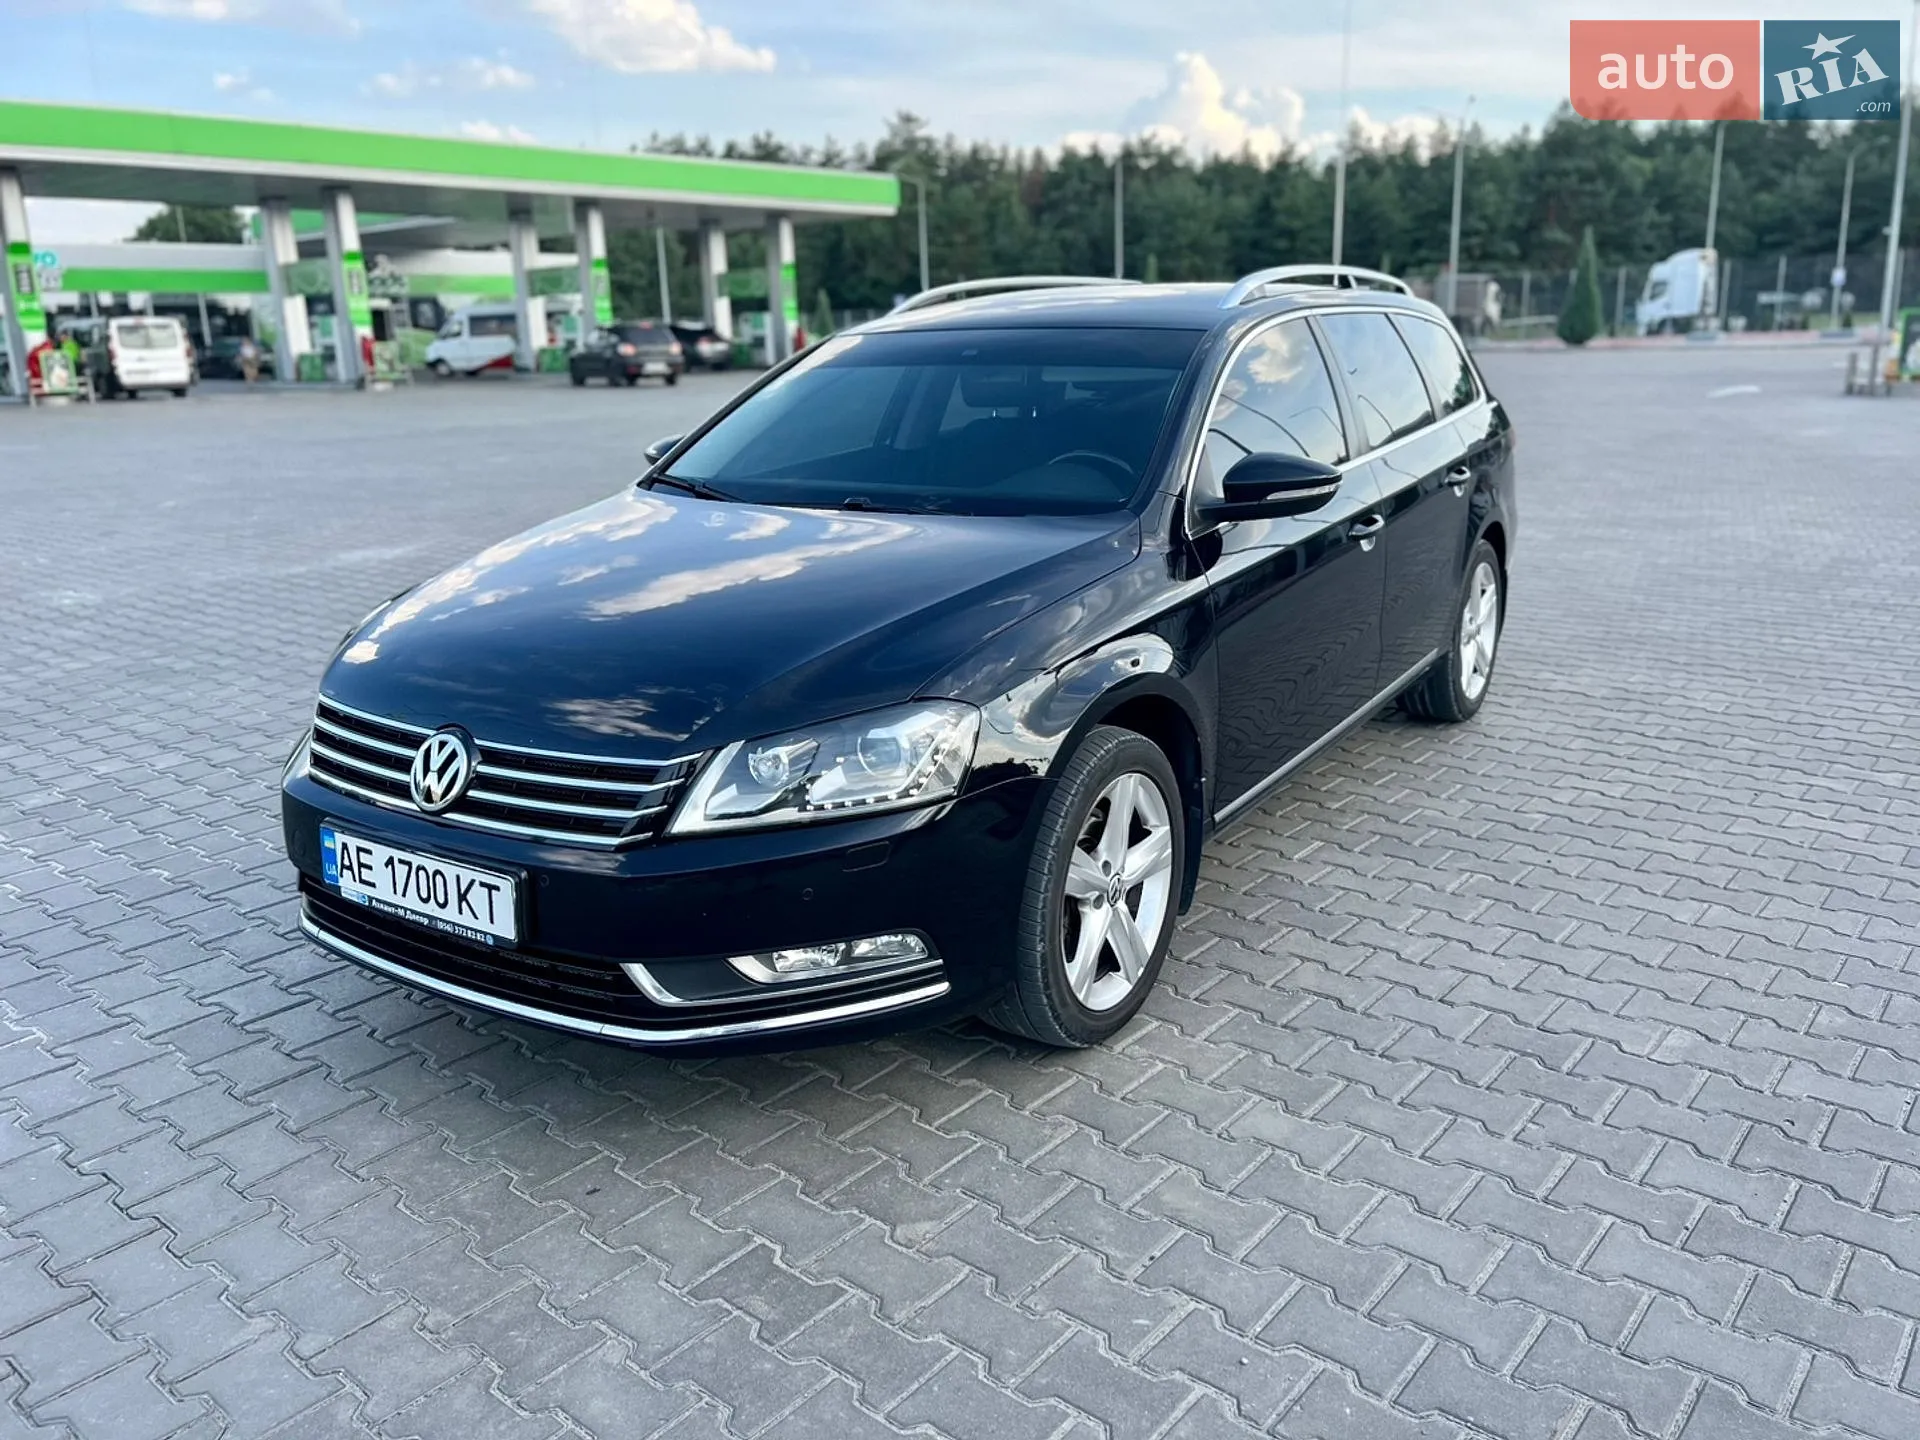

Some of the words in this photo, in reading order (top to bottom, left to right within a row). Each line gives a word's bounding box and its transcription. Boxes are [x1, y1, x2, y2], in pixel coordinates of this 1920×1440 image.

[325, 862, 337, 876] UA
[339, 841, 377, 888] AE
[384, 855, 448, 909] 1700
[455, 873, 501, 925] KT
